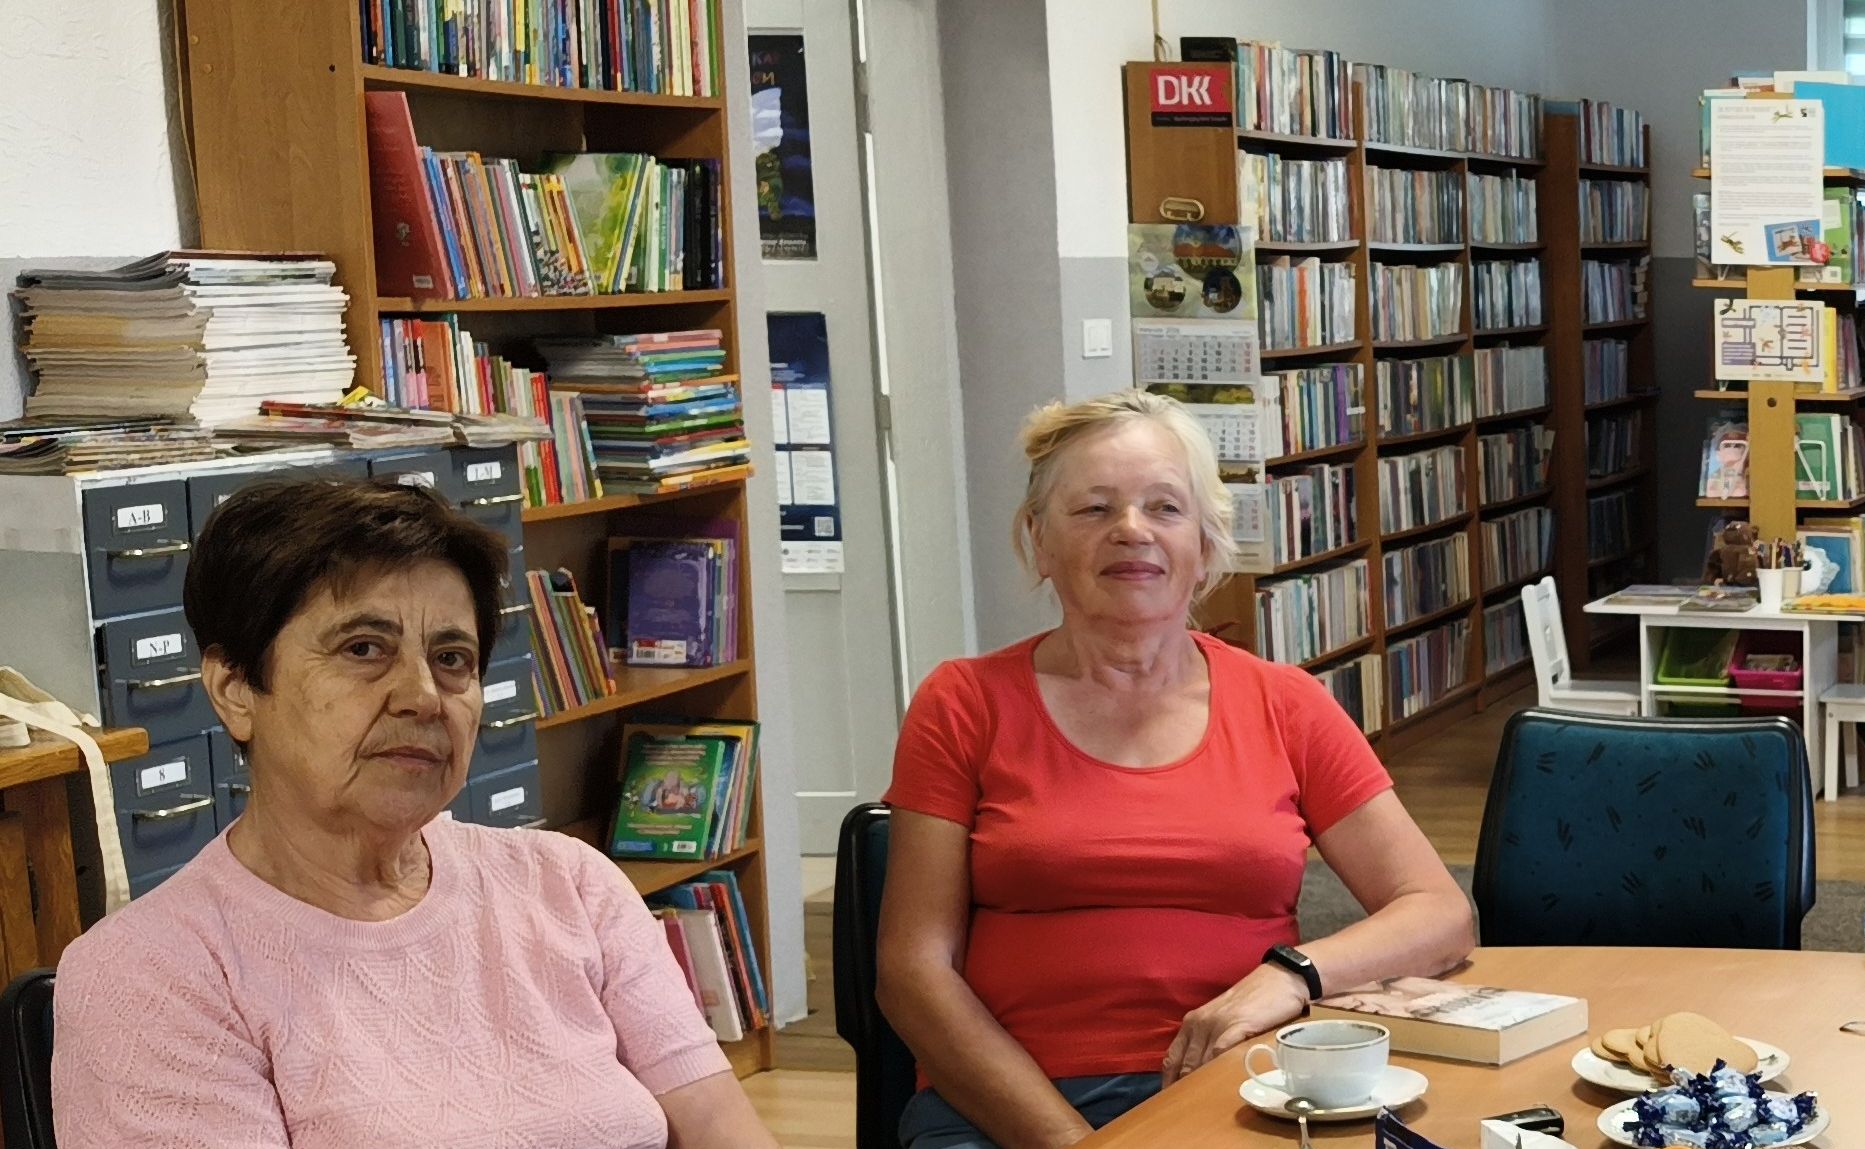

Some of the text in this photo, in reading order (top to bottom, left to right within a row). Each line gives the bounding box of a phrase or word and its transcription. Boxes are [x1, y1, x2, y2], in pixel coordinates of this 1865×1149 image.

[1156, 75, 1213, 106] DKK
[128, 509, 151, 525] A-B
[149, 640, 170, 657] N-P
